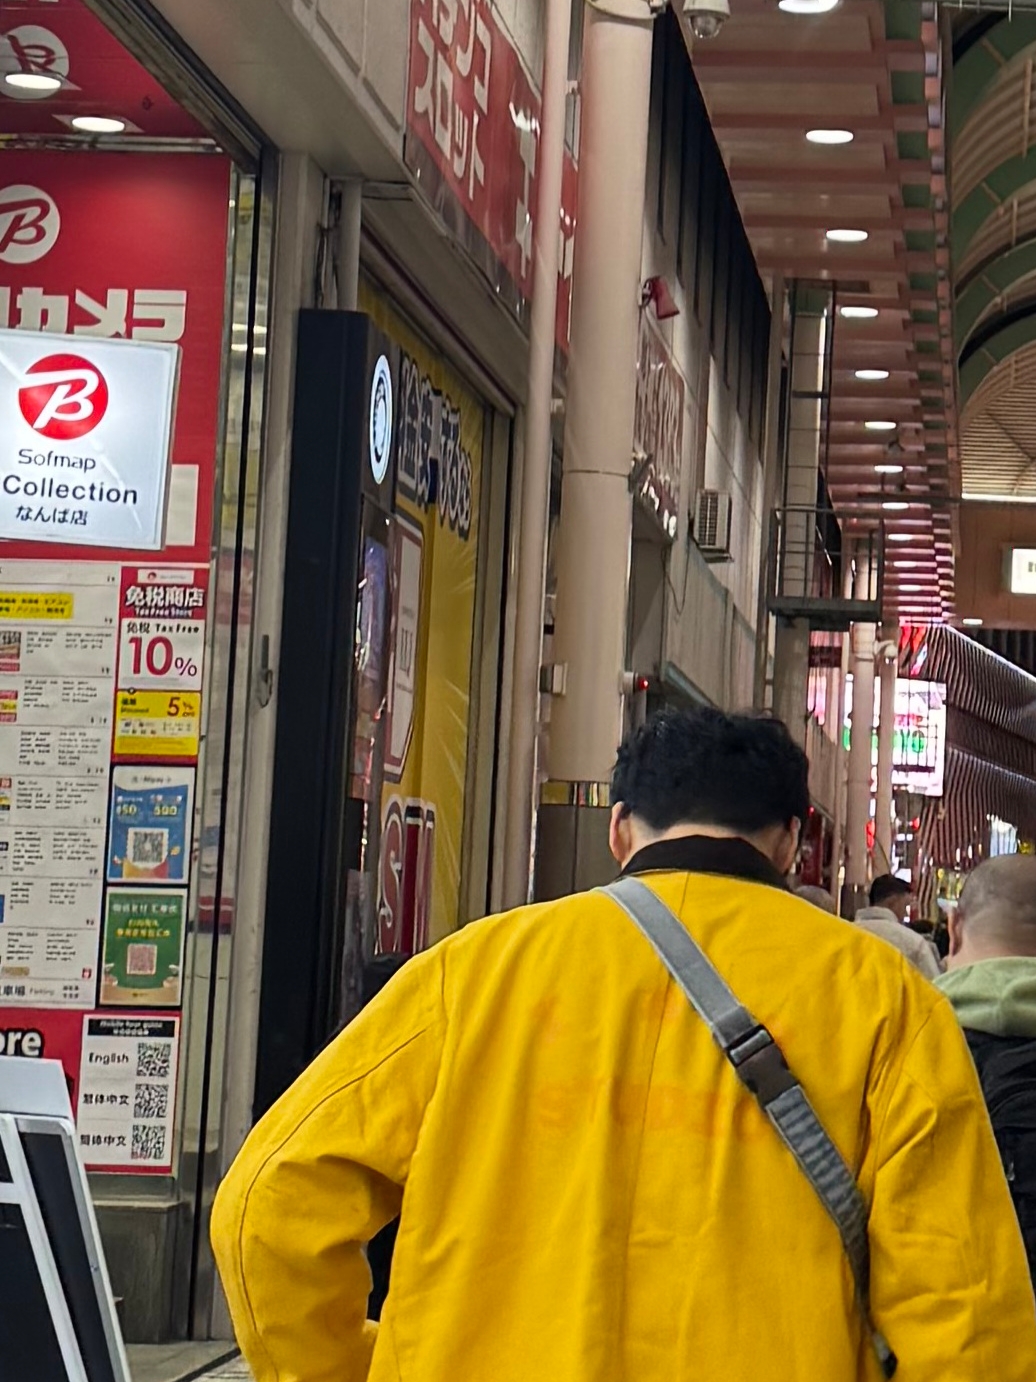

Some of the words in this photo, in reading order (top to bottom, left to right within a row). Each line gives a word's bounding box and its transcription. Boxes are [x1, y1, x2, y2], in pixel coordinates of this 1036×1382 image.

[413, 17, 485, 201] スロット
[0, 286, 187, 342] カメラ
[18, 448, 96, 474] Sofmap
[3, 474, 138, 505] Collection
[16, 505, 88, 526] なんば店
[129, 636, 197, 677] 10%
[0, 1031, 42, 1056] re
[89, 1052, 129, 1065] English
